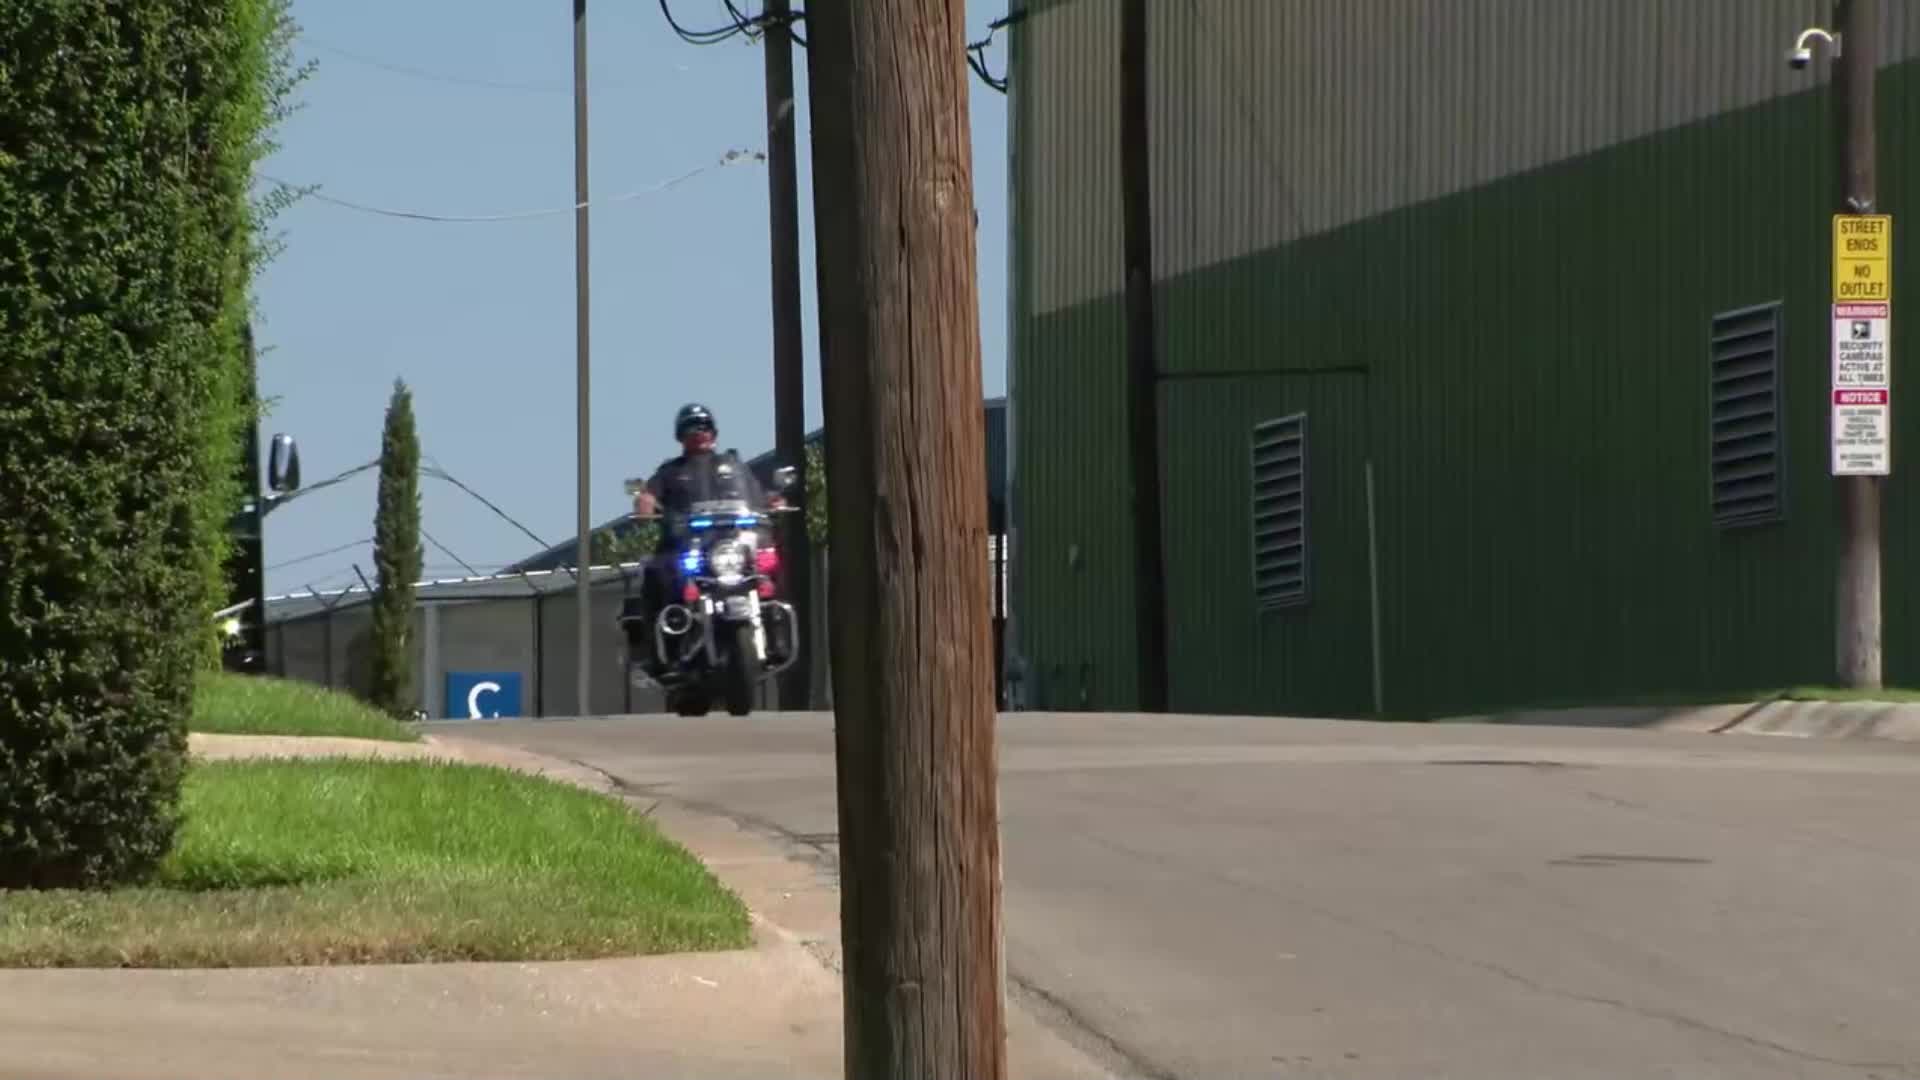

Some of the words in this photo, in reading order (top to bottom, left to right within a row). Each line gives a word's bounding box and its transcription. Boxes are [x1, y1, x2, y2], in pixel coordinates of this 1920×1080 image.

[1841, 221, 1884, 234] STREET
[1846, 238, 1878, 251] ENDS
[1854, 264, 1871, 278] NO
[1840, 281, 1883, 296] OUTLET
[1839, 342, 1883, 351] SECURITY
[1839, 352, 1883, 361] CAMERAS
[1839, 363, 1870, 371] ACTIVE
[1873, 363, 1883, 371] AT
[1838, 374, 1856, 382] ALL
[1857, 374, 1884, 382] TIMES
[1841, 392, 1881, 403] NOTICE
